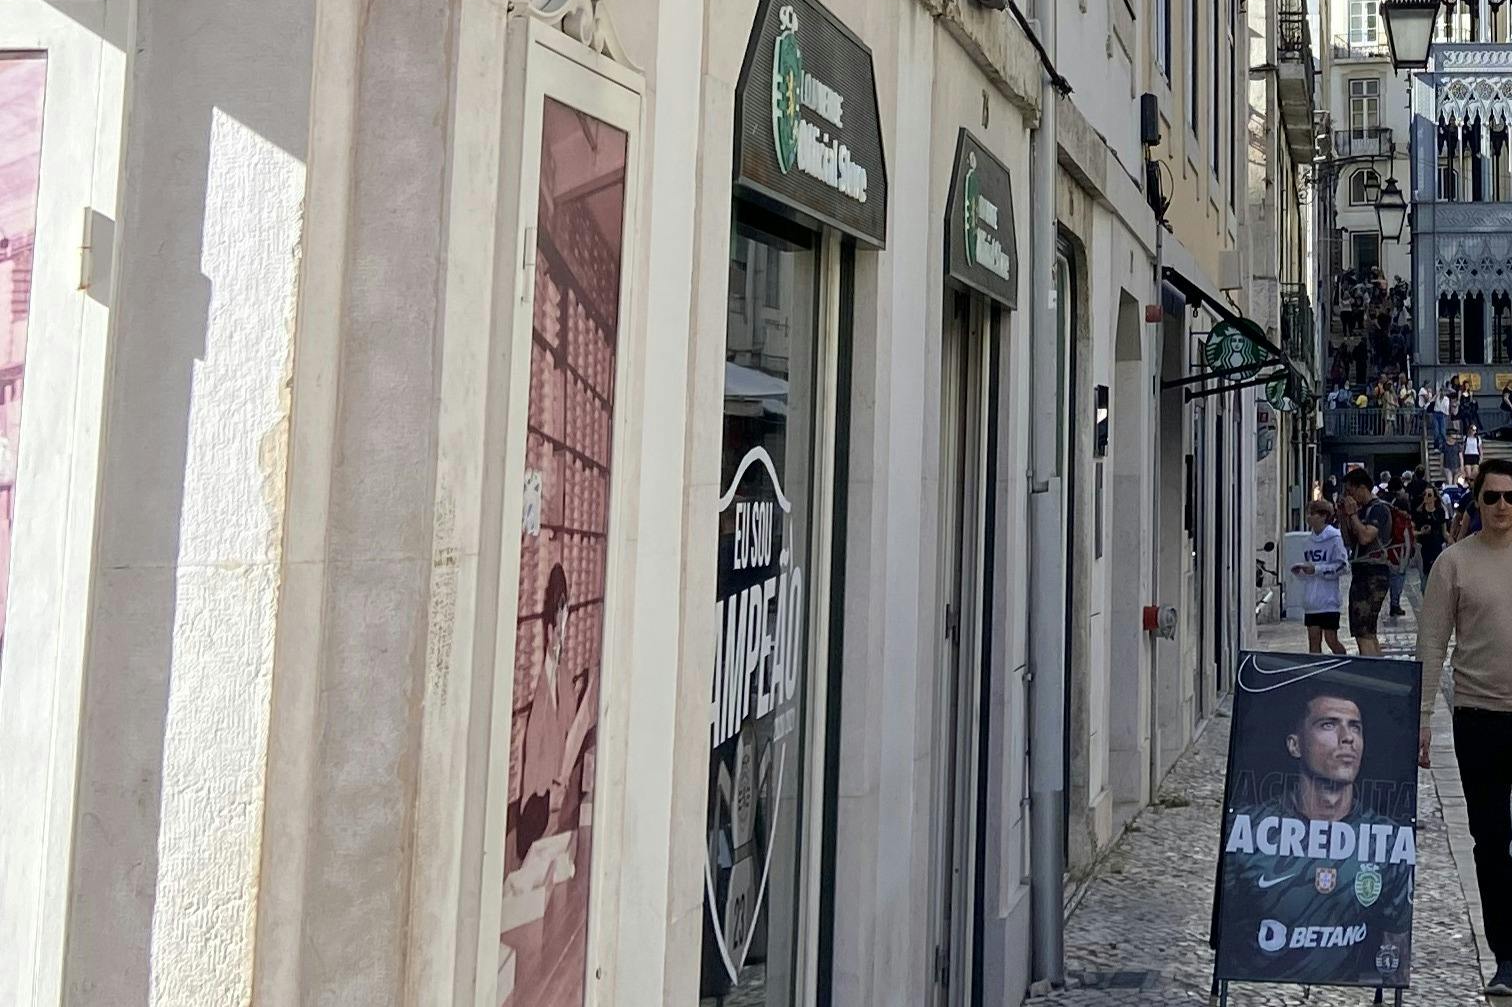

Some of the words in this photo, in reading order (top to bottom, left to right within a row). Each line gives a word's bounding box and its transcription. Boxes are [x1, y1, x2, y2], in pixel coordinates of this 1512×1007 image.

[734, 502, 750, 569] EU
[751, 501, 773, 568] SOU
[710, 547, 802, 749] AMPEÃO
[1225, 814, 1416, 866] ACREDITA
[1289, 922, 1367, 949] BETANO
